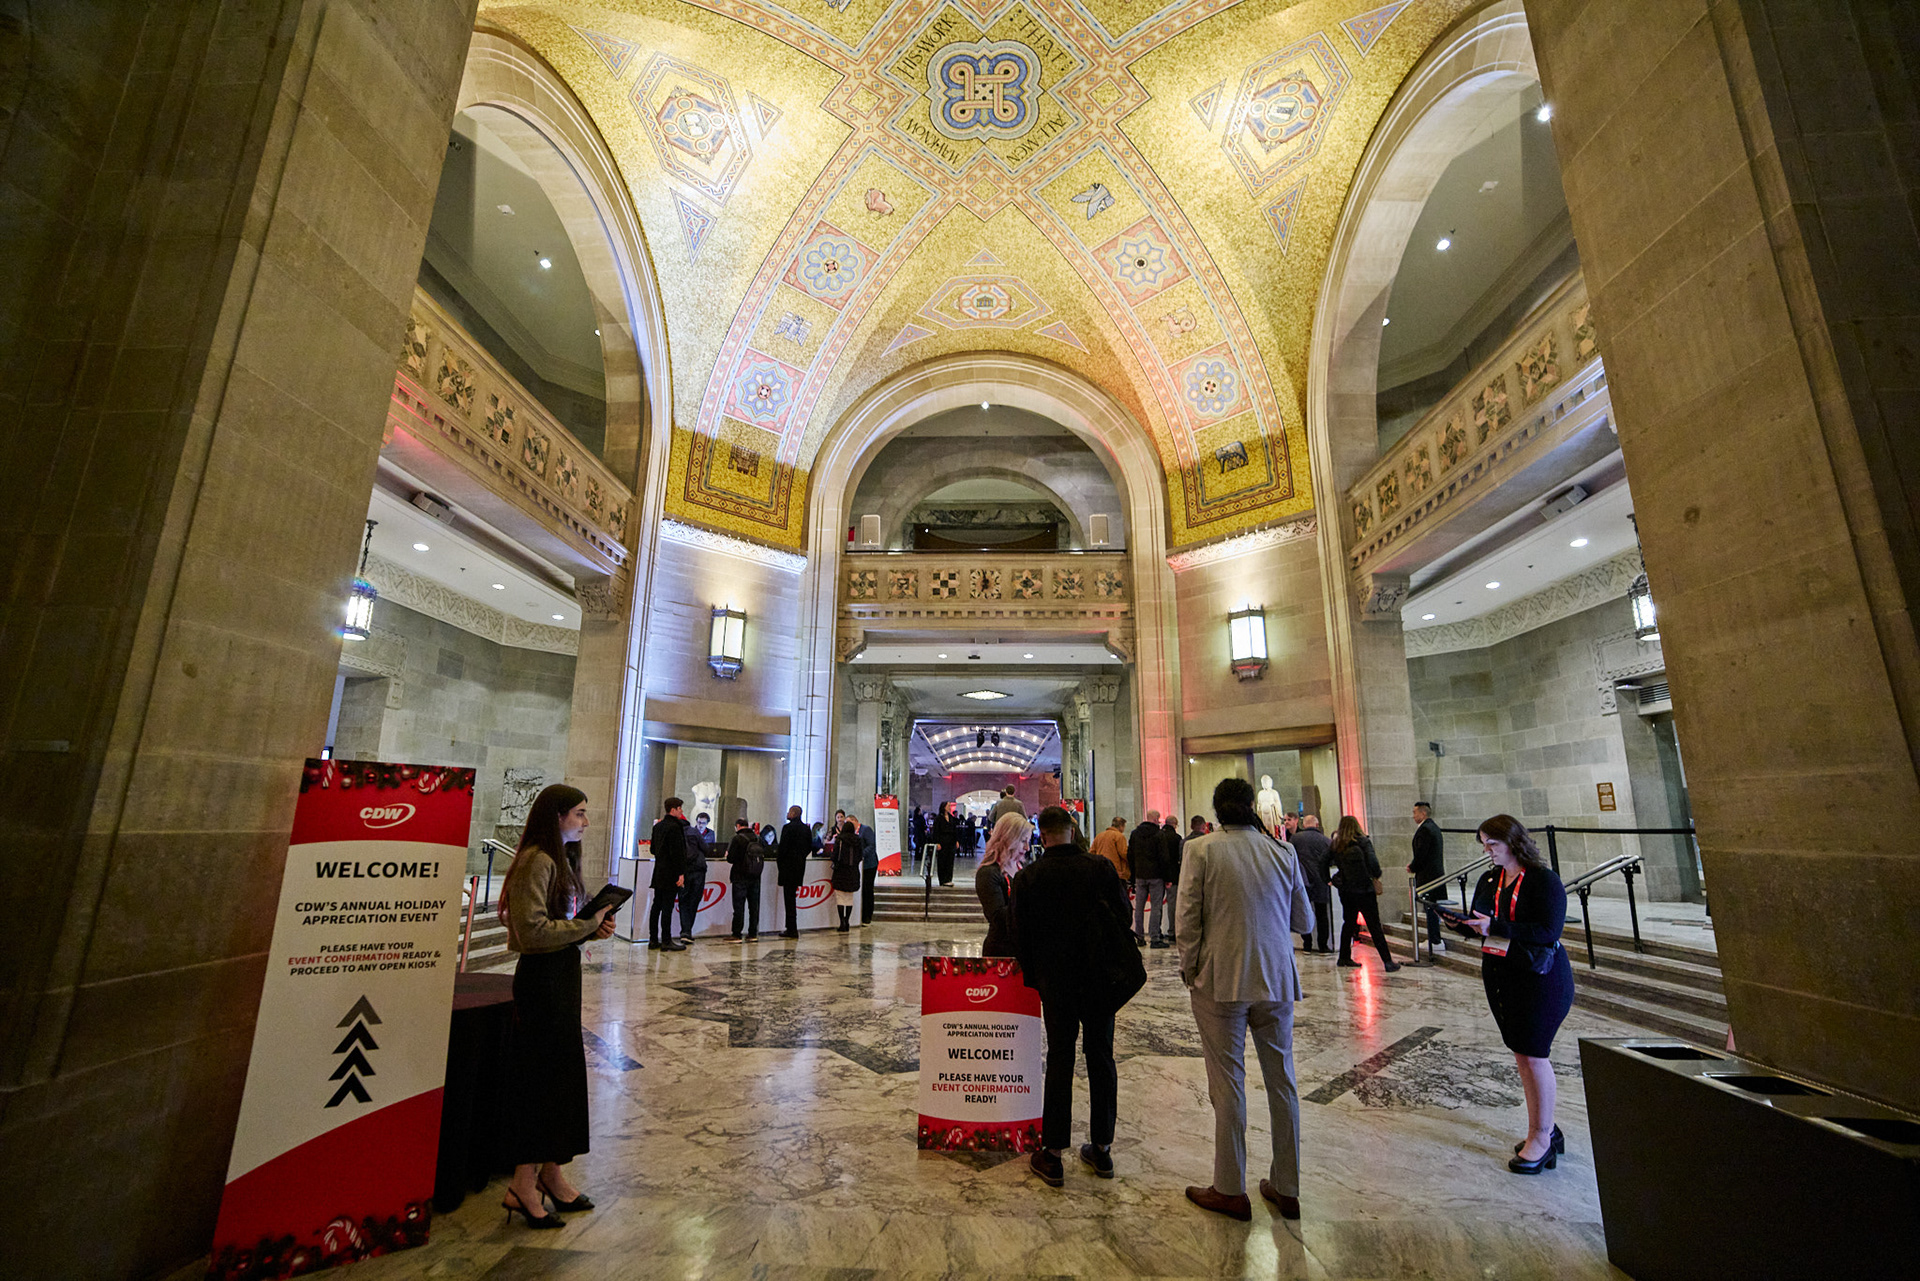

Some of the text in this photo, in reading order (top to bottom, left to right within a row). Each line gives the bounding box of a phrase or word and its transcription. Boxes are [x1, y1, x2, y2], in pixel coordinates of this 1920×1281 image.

[360, 806, 403, 820] CDW
[316, 861, 440, 879] WELCOME!
[295, 900, 447, 913] CDW'S ANNUAL HOLIDAY
[302, 912, 438, 925] APPRECIATION EVENT
[320, 941, 414, 953] PLEASE HAVE YOUR
[288, 950, 441, 965] EVENT CONFIRMATION READY &
[290, 960, 437, 976] PROCEED TO ANY OPEN KIOSK
[947, 1030, 994, 1038] APPRECIATION
[948, 1047, 1014, 1061] WELCOME!
[939, 1073, 1024, 1083] PLEASE HAVE YOUR
[932, 1083, 1030, 1094] EVENT CONFIRMATION
[965, 1095, 997, 1104] READY!
